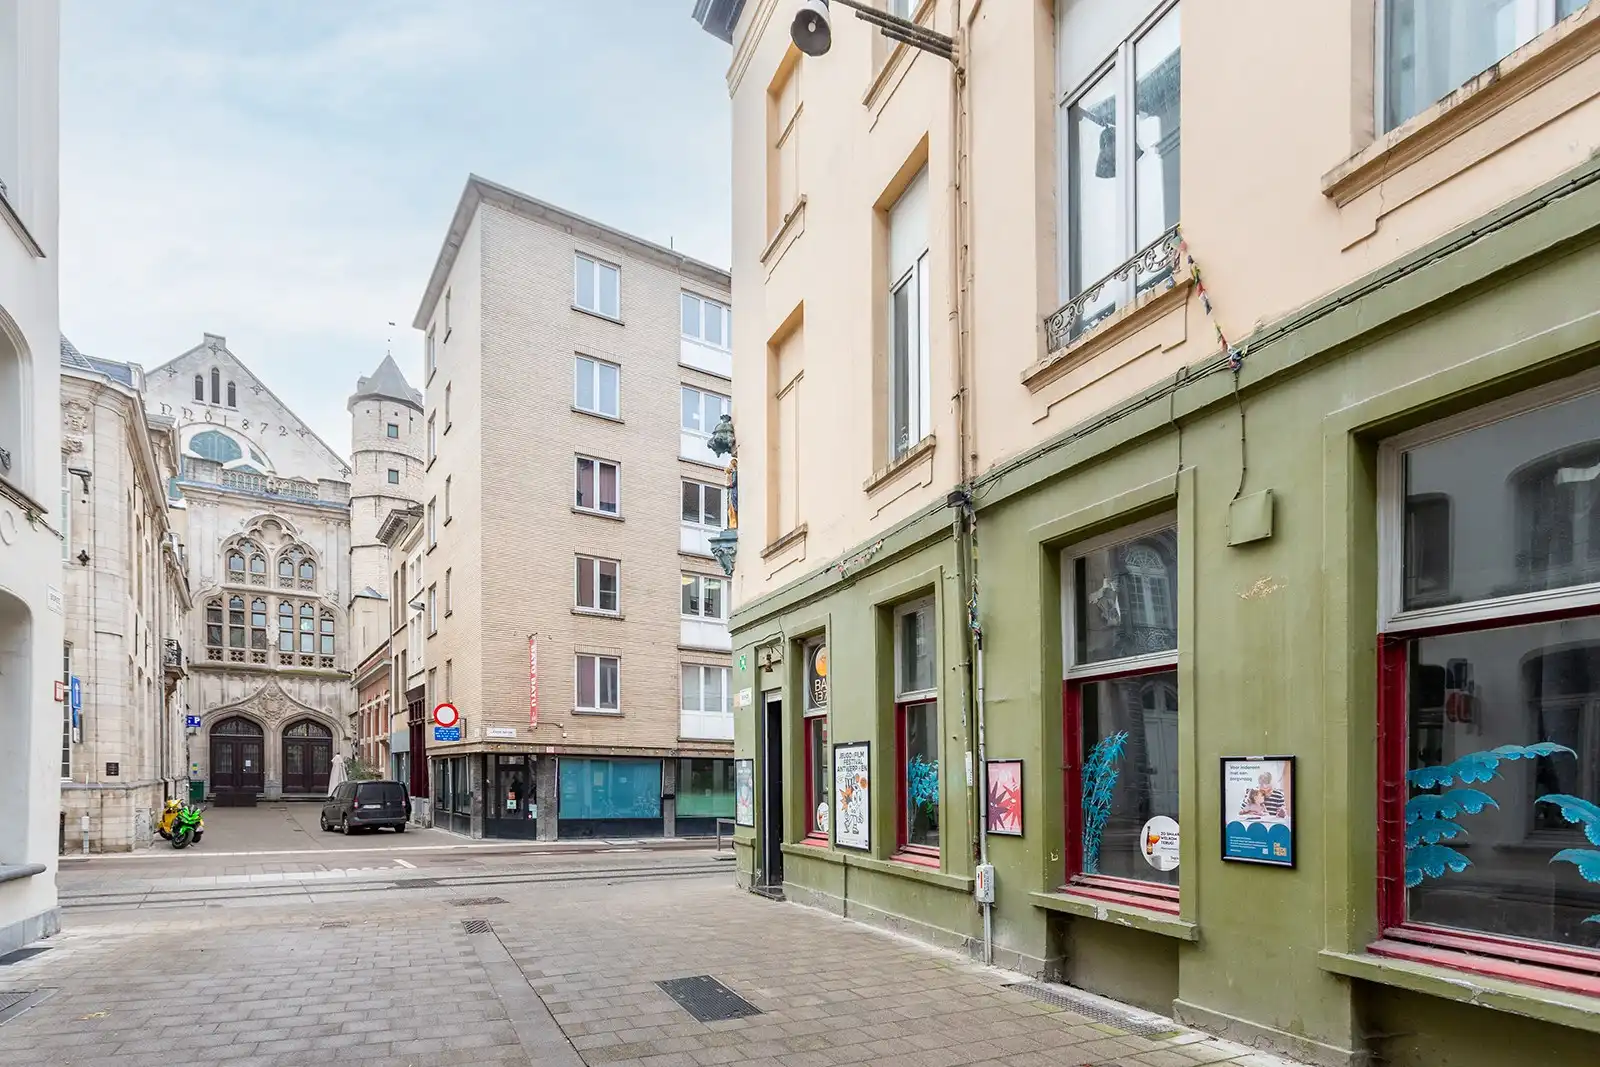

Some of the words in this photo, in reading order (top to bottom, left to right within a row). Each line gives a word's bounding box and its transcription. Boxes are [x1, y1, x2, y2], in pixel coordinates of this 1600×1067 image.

[223, 415, 289, 437] 1872
[814, 677, 828, 692] BA
[194, 716, 201, 724] P
